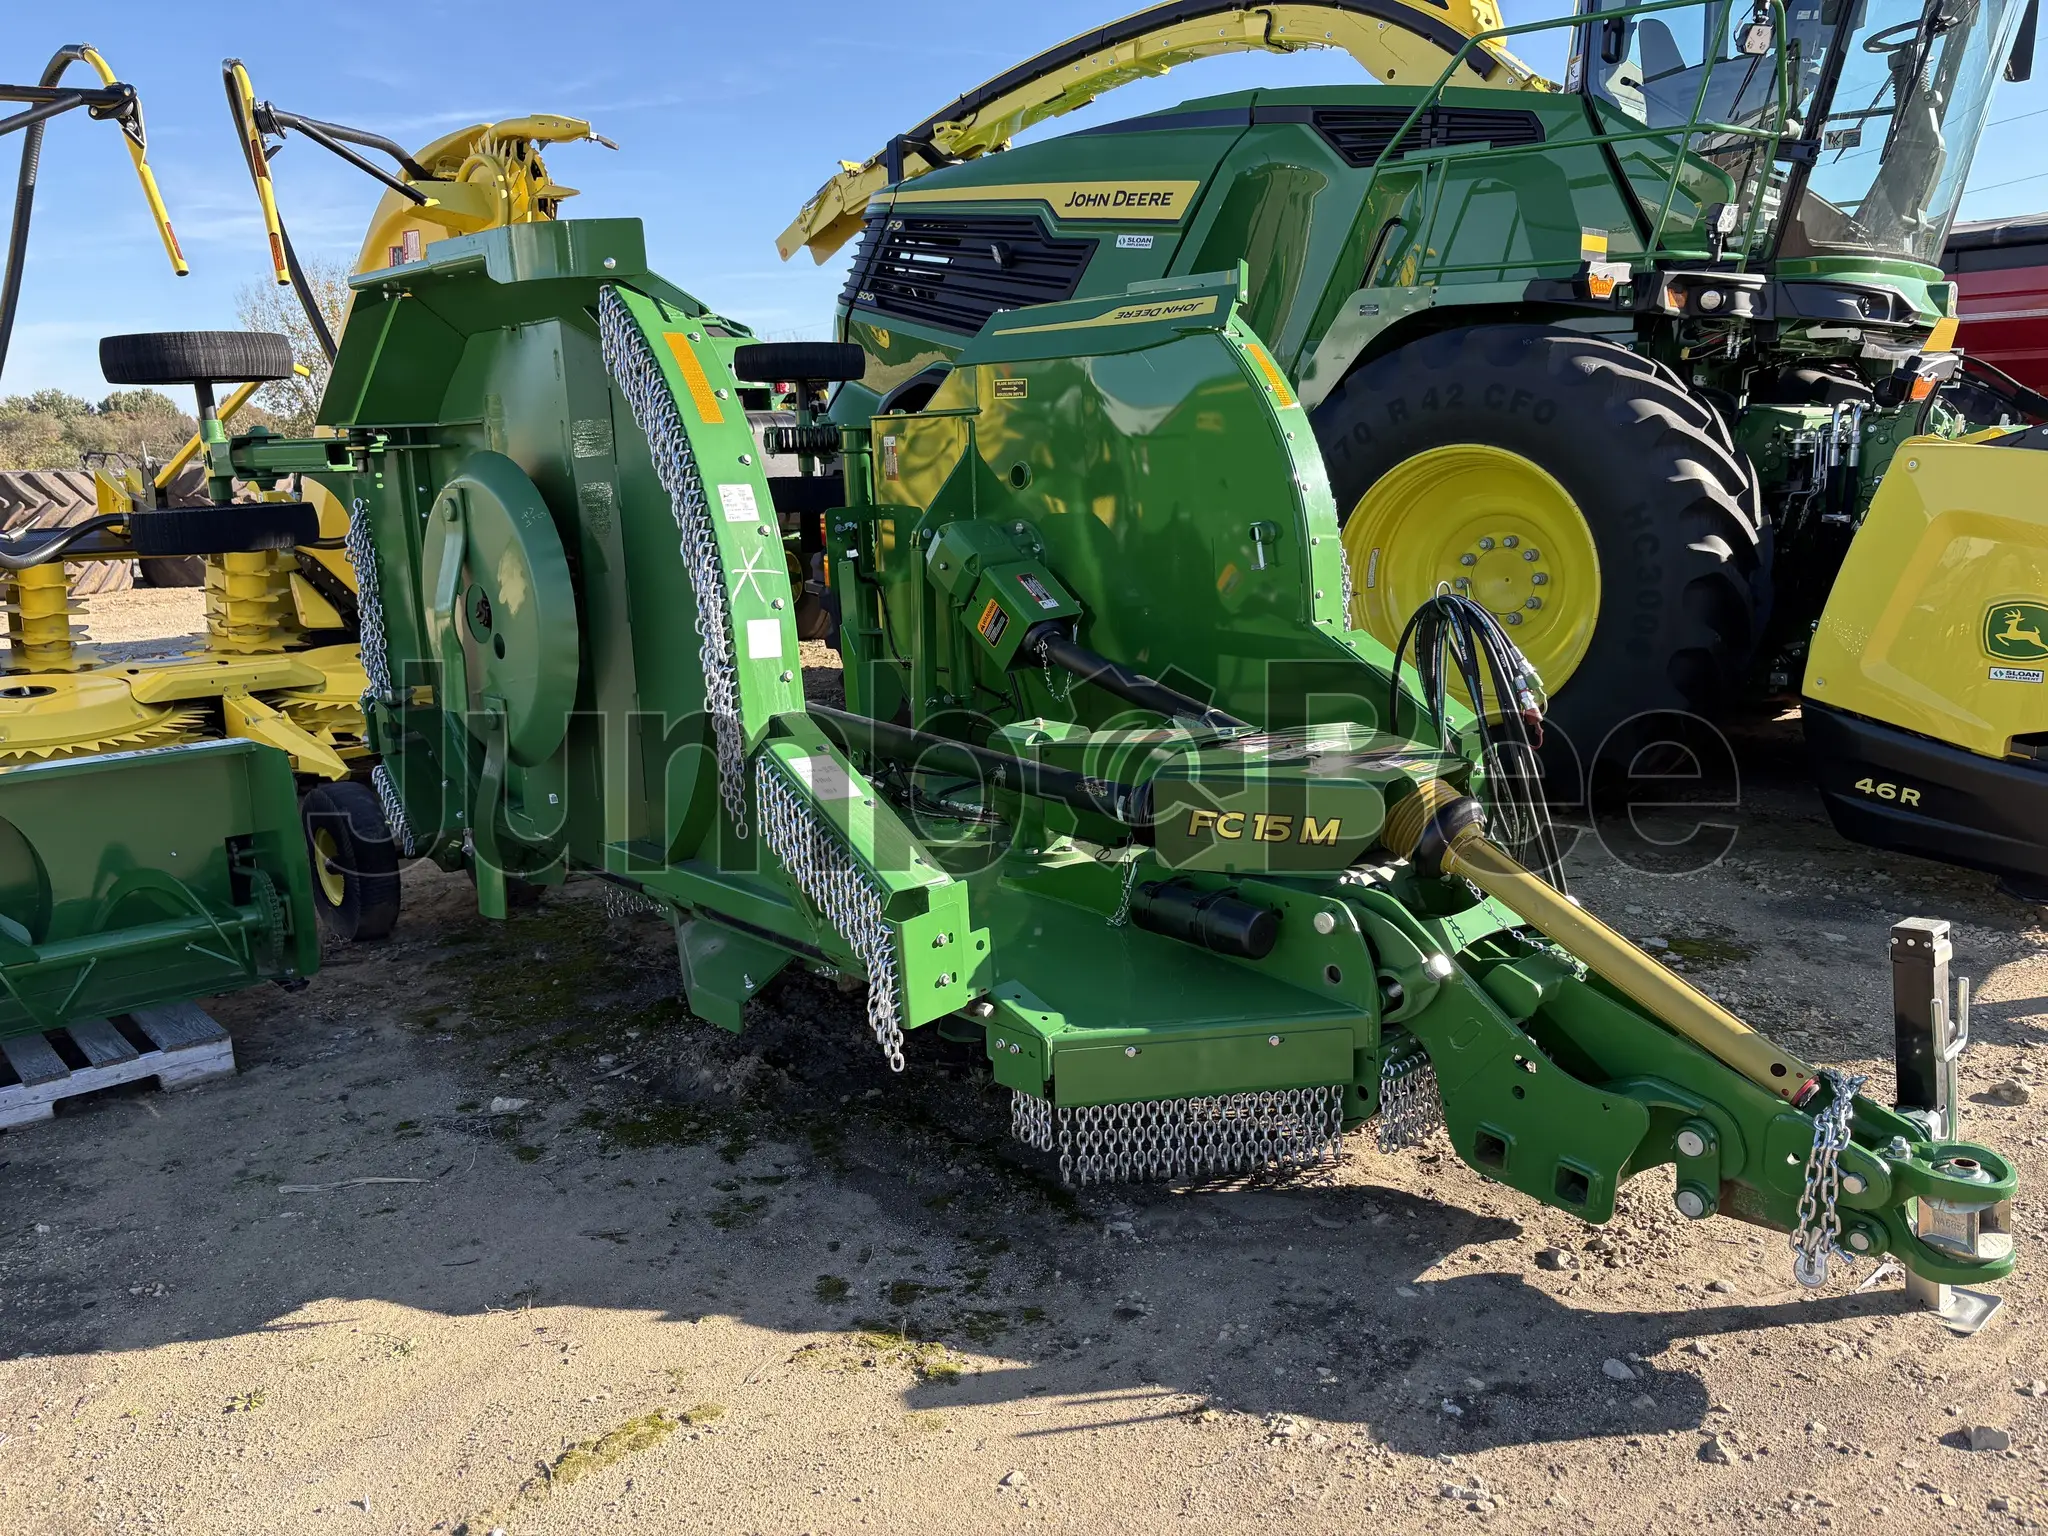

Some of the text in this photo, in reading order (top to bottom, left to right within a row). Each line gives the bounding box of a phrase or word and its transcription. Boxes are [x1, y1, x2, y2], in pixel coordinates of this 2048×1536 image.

[1065, 190, 1174, 207] JOHN DEERE
[886, 220, 903, 231] F9
[857, 291, 875, 301] 500
[1114, 301, 1205, 320] JOHN DEERE
[1386, 398, 1411, 425] R
[1421, 383, 1466, 412] 42
[1484, 383, 1558, 426] CFO
[2005, 670, 2040, 678] SLOAN
